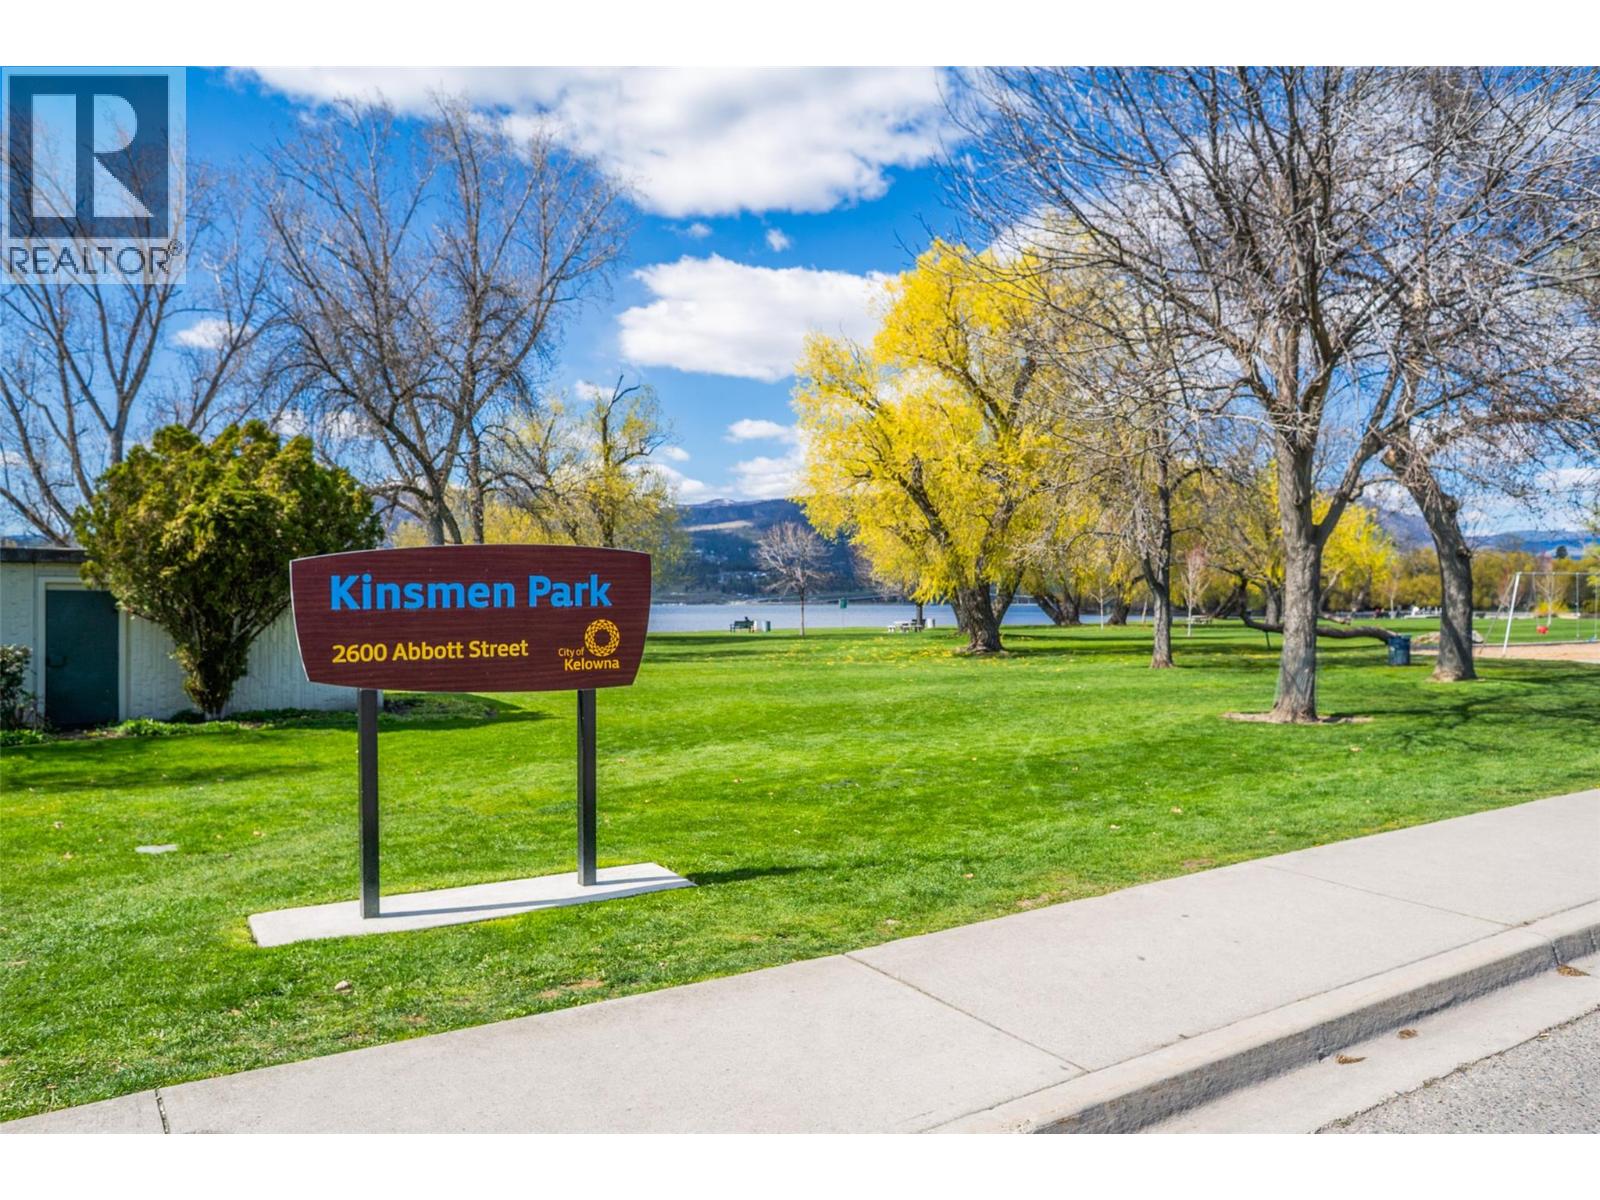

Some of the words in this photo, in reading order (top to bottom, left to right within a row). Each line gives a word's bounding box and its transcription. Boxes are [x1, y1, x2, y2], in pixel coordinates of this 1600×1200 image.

[330, 574, 515, 611] Kinsmen
[528, 574, 612, 608] Park
[332, 644, 388, 663] 2600
[392, 642, 464, 661] Abbott
[469, 640, 528, 658] Street
[558, 648, 575, 659] City
[576, 647, 585, 657] of
[564, 658, 620, 671] Kelowna
